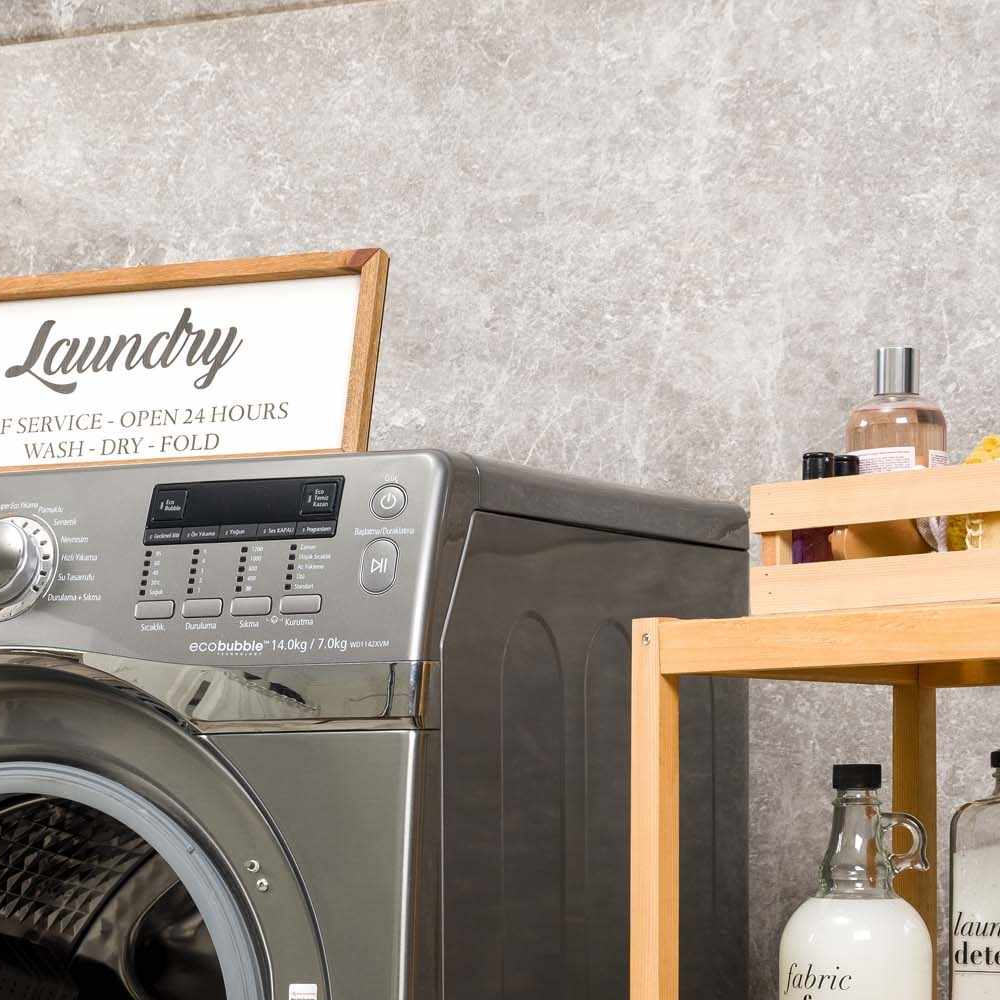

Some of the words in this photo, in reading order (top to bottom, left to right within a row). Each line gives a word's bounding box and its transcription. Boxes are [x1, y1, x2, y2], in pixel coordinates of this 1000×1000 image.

[4, 307, 244, 395] Laundry
[17, 413, 104, 435] SERVICE
[120, 408, 180, 429] OPEN
[183, 407, 206, 425] 24
[210, 401, 290, 423] HOURS
[24, 440, 85, 460] WASH
[101, 437, 144, 456] DRY
[160, 433, 221, 453] FOLD
[271, 638, 308, 653] 14.0kg
[317, 637, 348, 652] 7.0kg
[783, 962, 852, 995] fabric
